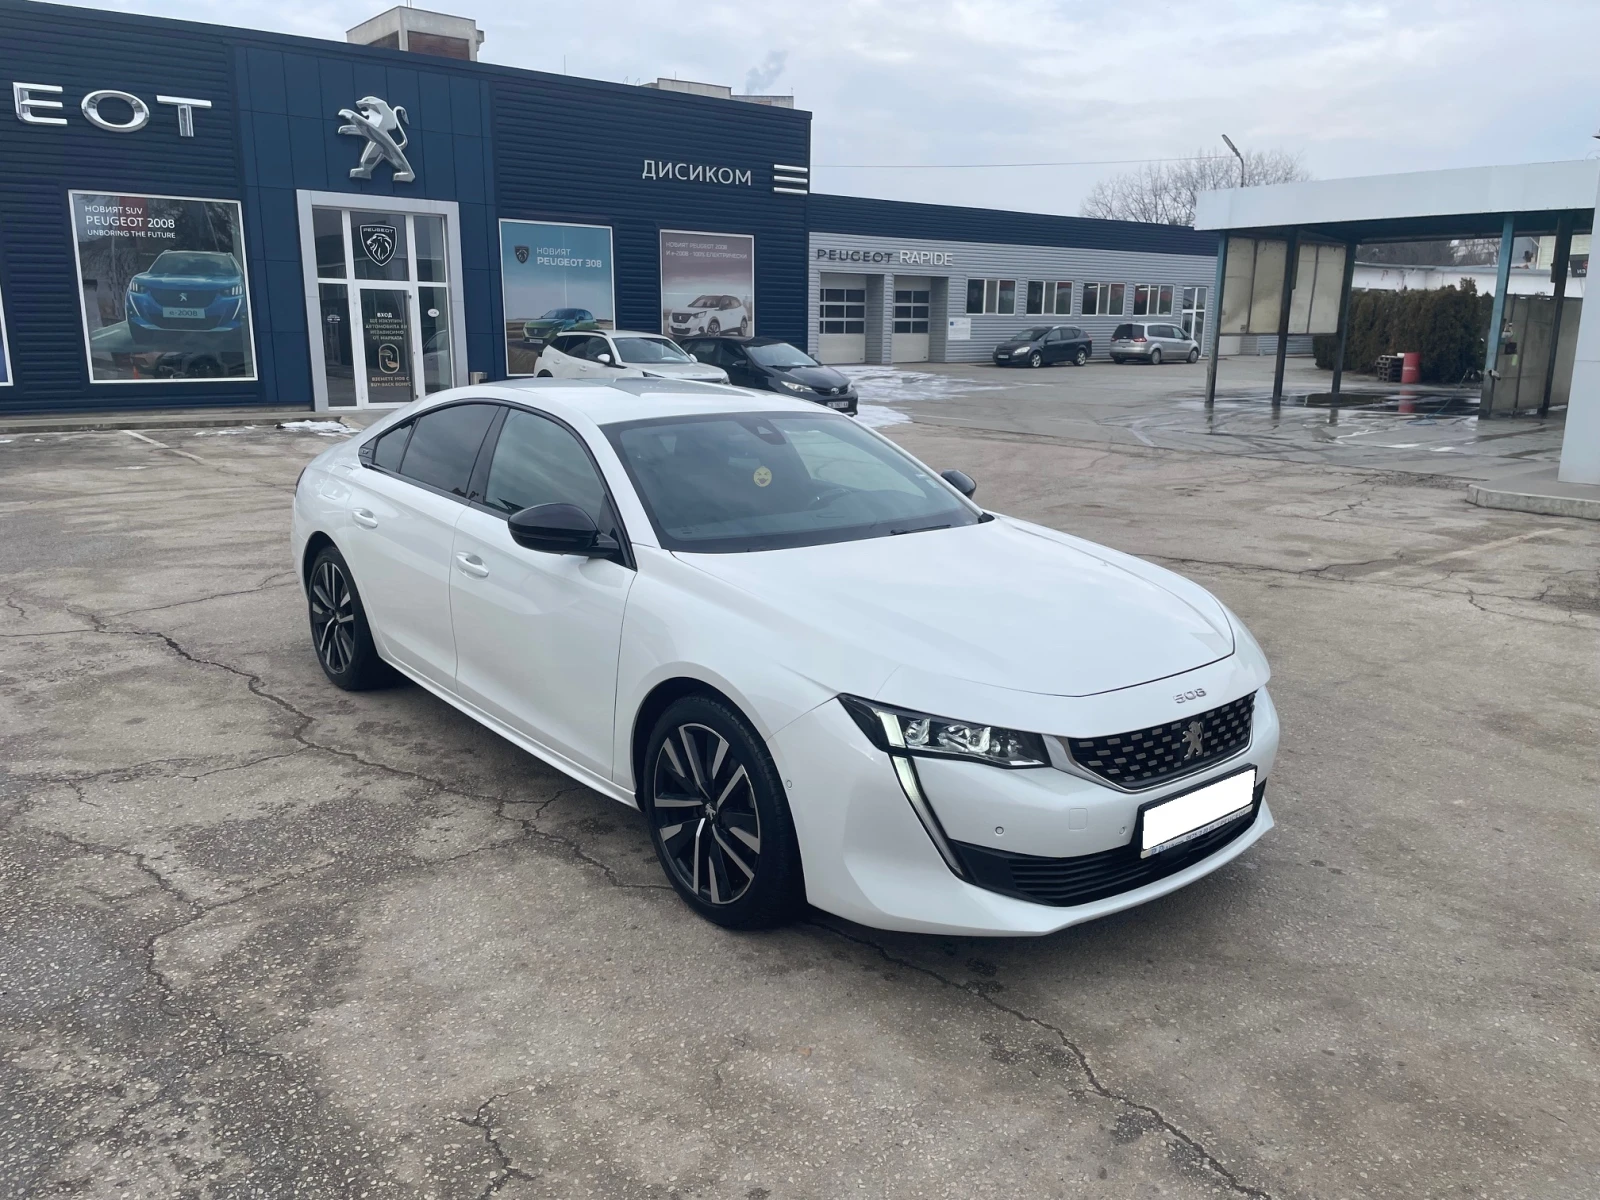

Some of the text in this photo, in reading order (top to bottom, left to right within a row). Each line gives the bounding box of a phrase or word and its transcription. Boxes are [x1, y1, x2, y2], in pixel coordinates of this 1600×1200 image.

[642, 159, 752, 187] ДИСИКОМ
[84, 205, 143, 215] НОВИЯТ SUV
[85, 215, 176, 229] PEUGEOT 2008
[87, 229, 176, 239] UNBORING THE FUTURE
[536, 246, 571, 256] НОВИЯТ
[816, 248, 954, 266] PEUGEOT RAPIDE
[537, 256, 602, 268] PEUGEOT 308
